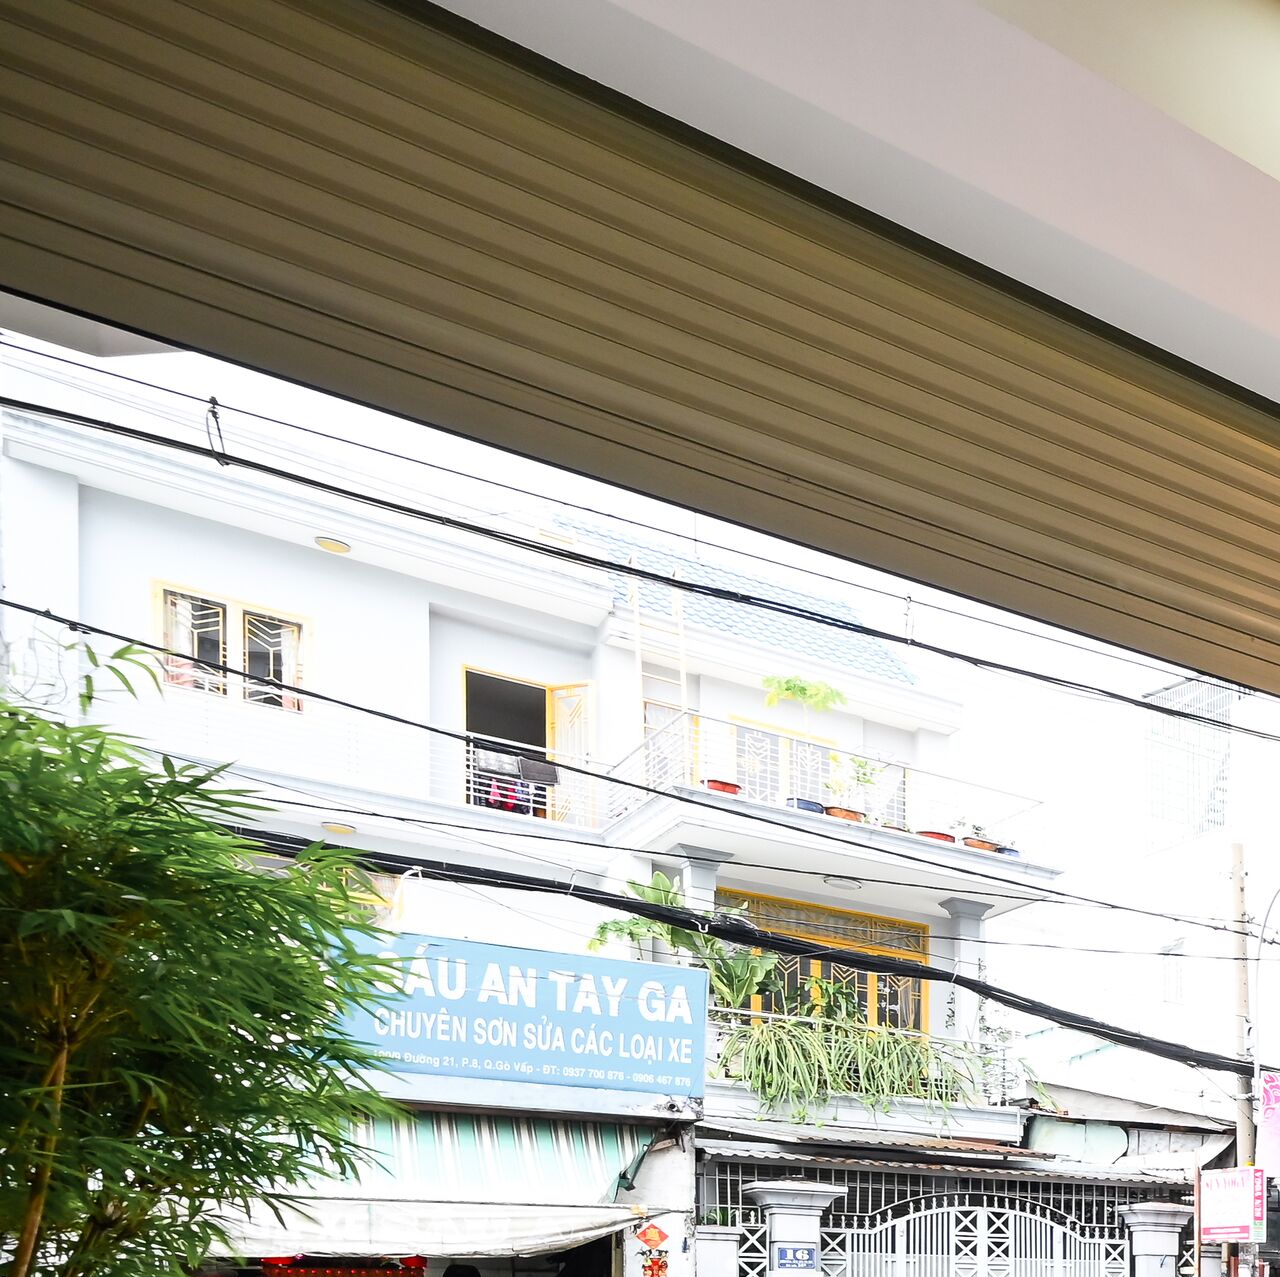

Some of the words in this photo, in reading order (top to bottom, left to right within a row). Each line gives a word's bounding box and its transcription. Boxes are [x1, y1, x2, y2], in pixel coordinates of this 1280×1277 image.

[476, 962, 537, 1009] AN
[547, 968, 629, 1017] TAY
[637, 980, 694, 1025] GA
[373, 1007, 467, 1043] CHUYÊN
[473, 1016, 517, 1048] SƠN
[522, 1015, 566, 1052] SỬA
[570, 1023, 614, 1057] CÁC
[618, 1032, 664, 1065] LOẠI
[667, 1037, 694, 1064] XE
[403, 1051, 440, 1068] Đường
[785, 1249, 810, 1261] 16
